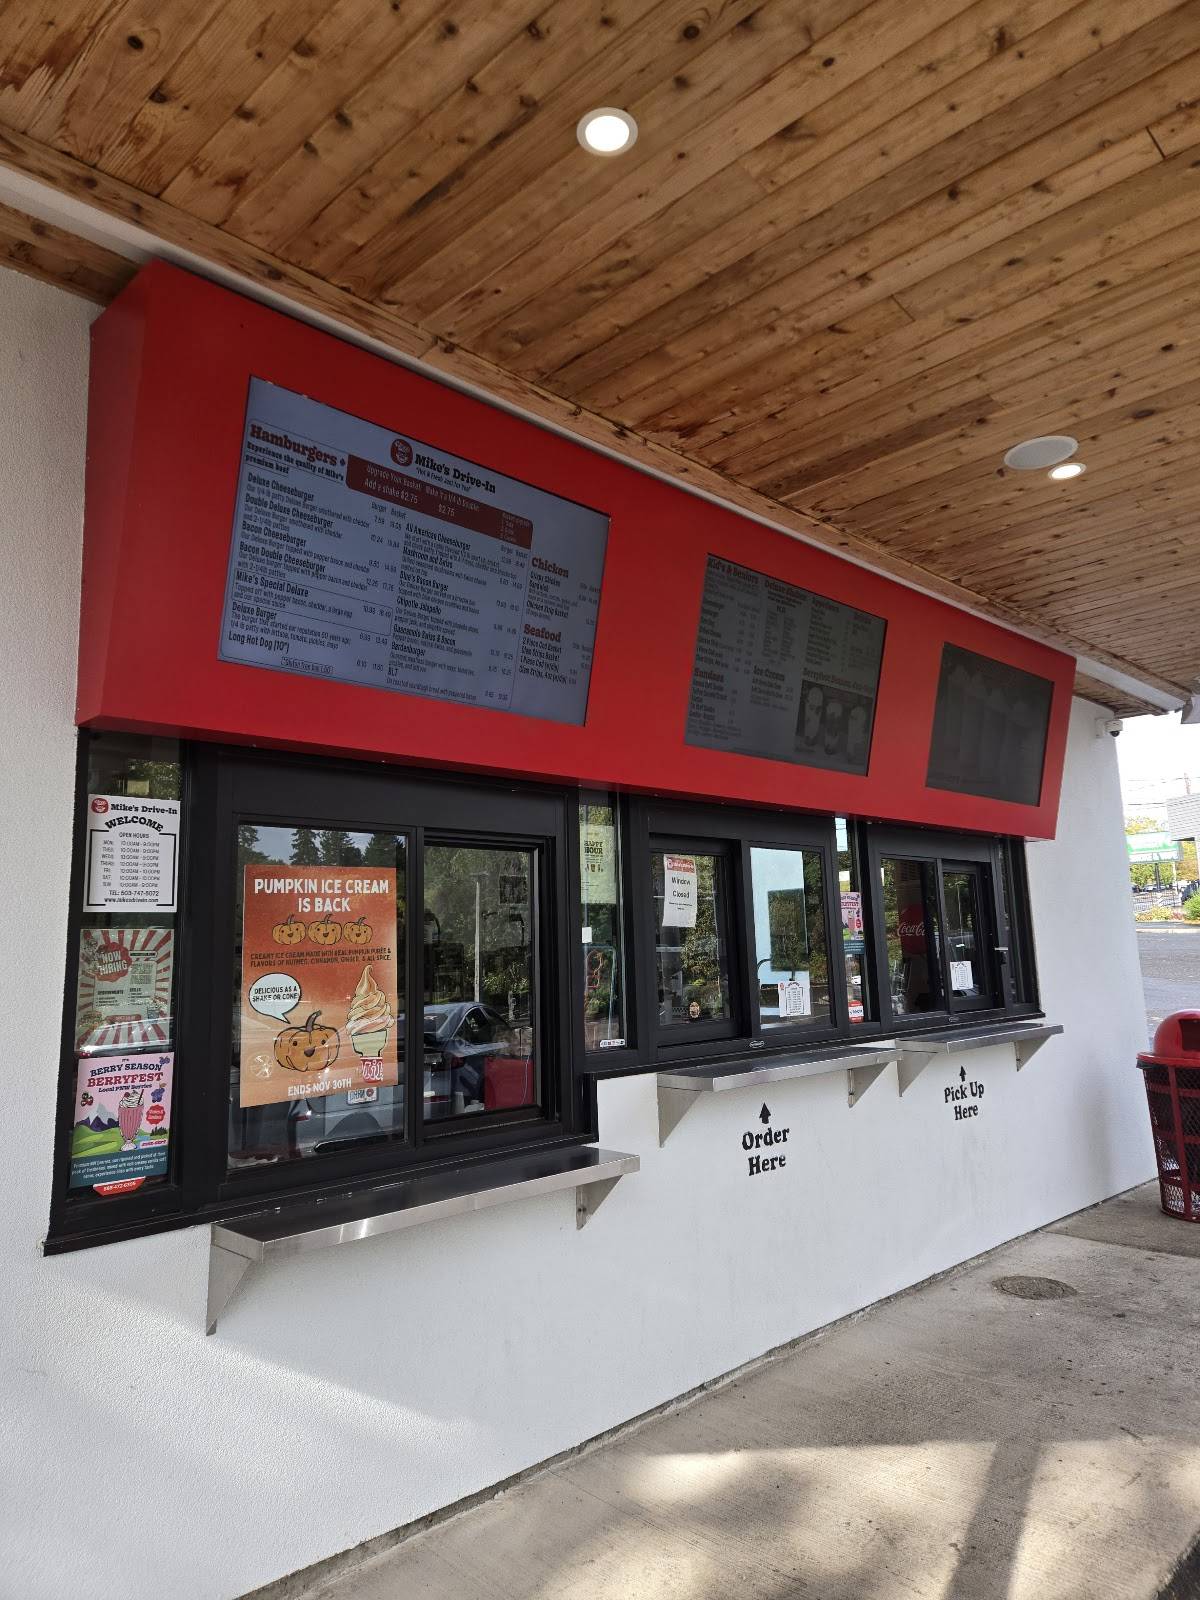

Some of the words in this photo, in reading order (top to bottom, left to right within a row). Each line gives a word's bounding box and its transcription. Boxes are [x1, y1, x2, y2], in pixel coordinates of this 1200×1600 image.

[249, 423, 337, 467] Hamburgers
[246, 441, 283, 460] Experience
[284, 454, 294, 464] the
[295, 459, 317, 473] quality
[317, 466, 324, 474] of
[325, 468, 344, 481] Mike's
[414, 453, 450, 476] Mike's
[452, 468, 496, 494] Drive-In
[248, 472, 270, 488] Deluxe
[271, 480, 314, 502] Cheeseburger
[364, 479, 376, 490] Add
[400, 491, 418, 504] $2.75
[245, 493, 268, 508] Double
[269, 500, 291, 515] Deluxe
[291, 507, 334, 528] Cheeseburger
[438, 503, 455, 517] $2.75
[242, 520, 262, 534] Bacon
[263, 526, 307, 547] Cheeseburger
[239, 541, 260, 555] Bacon
[260, 547, 283, 561] Double
[283, 553, 326, 573] Cheeseburger
[531, 557, 569, 578] Chicken
[236, 570, 259, 585] Mike's
[260, 576, 286, 592] Special
[286, 583, 309, 597] Deluxe
[232, 601, 255, 615] Deluxe
[256, 607, 277, 620] Burger
[228, 630, 245, 645] Long
[245, 634, 259, 645] Hot
[259, 636, 273, 650] Dog
[523, 623, 562, 643] Seafood
[111, 803, 139, 812] Mike's
[141, 806, 177, 815] Drive-In
[105, 816, 163, 832] WELCOME
[254, 879, 317, 894] PUMPKIN
[321, 880, 342, 894] ICE
[346, 880, 389, 894] CREAM
[673, 890, 690, 899] Closed
[298, 897, 311, 912] IS
[314, 897, 352, 912] BACK
[102, 950, 121, 964] NOW
[251, 952, 274, 960] CREAMY
[251, 960, 276, 968] FLAVORS
[100, 960, 128, 975] HIRING
[252, 994, 271, 1002] SHAKE
[254, 986, 283, 994] DELICIOUS
[90, 1064, 123, 1077] BERRY
[125, 1063, 162, 1072] SEASON
[87, 1072, 163, 1087] BERRYFEST
[288, 1085, 311, 1096] ENDS
[313, 1082, 330, 1095] NOV
[333, 1078, 352, 1090] 30TH
[944, 1084, 967, 1103] Pick
[970, 1081, 985, 1098] Up
[954, 1105, 978, 1120] Here
[742, 1127, 790, 1151] Order
[748, 1154, 786, 1176] Here
